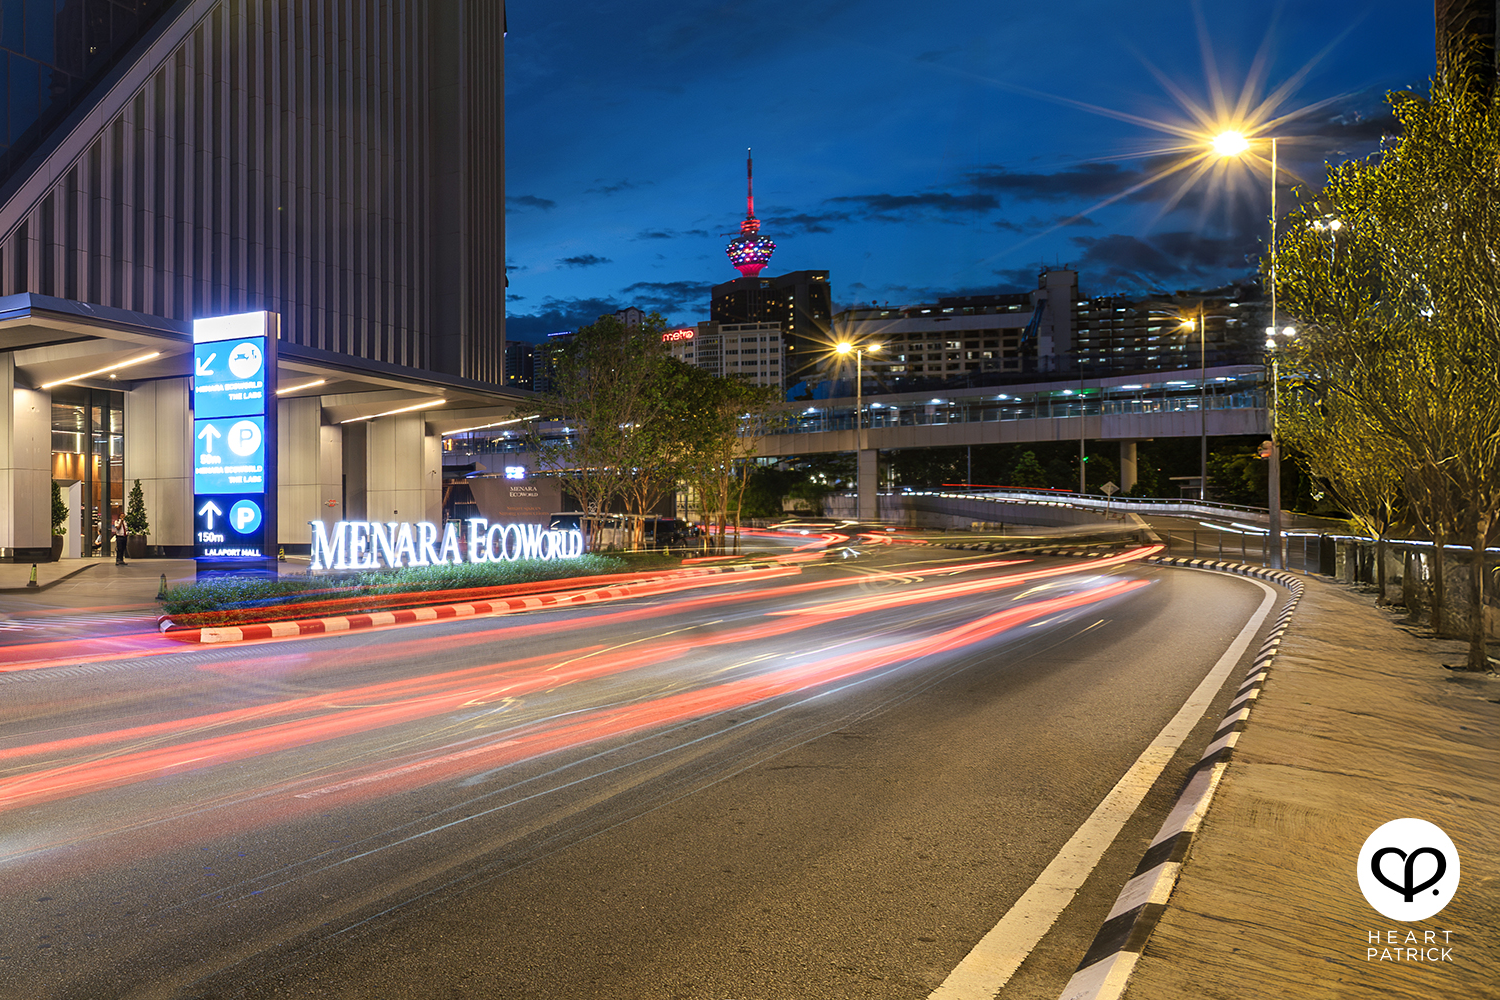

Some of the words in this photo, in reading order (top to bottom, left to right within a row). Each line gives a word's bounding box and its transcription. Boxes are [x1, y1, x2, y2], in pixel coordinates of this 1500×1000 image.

[662, 329, 694, 342] metro
[239, 429, 253, 448] P
[237, 507, 255, 530] P
[197, 531, 225, 543] 150m
[308, 520, 462, 570] MENARA
[204, 548, 241, 557] LALAPORT
[241, 548, 261, 557] MALL
